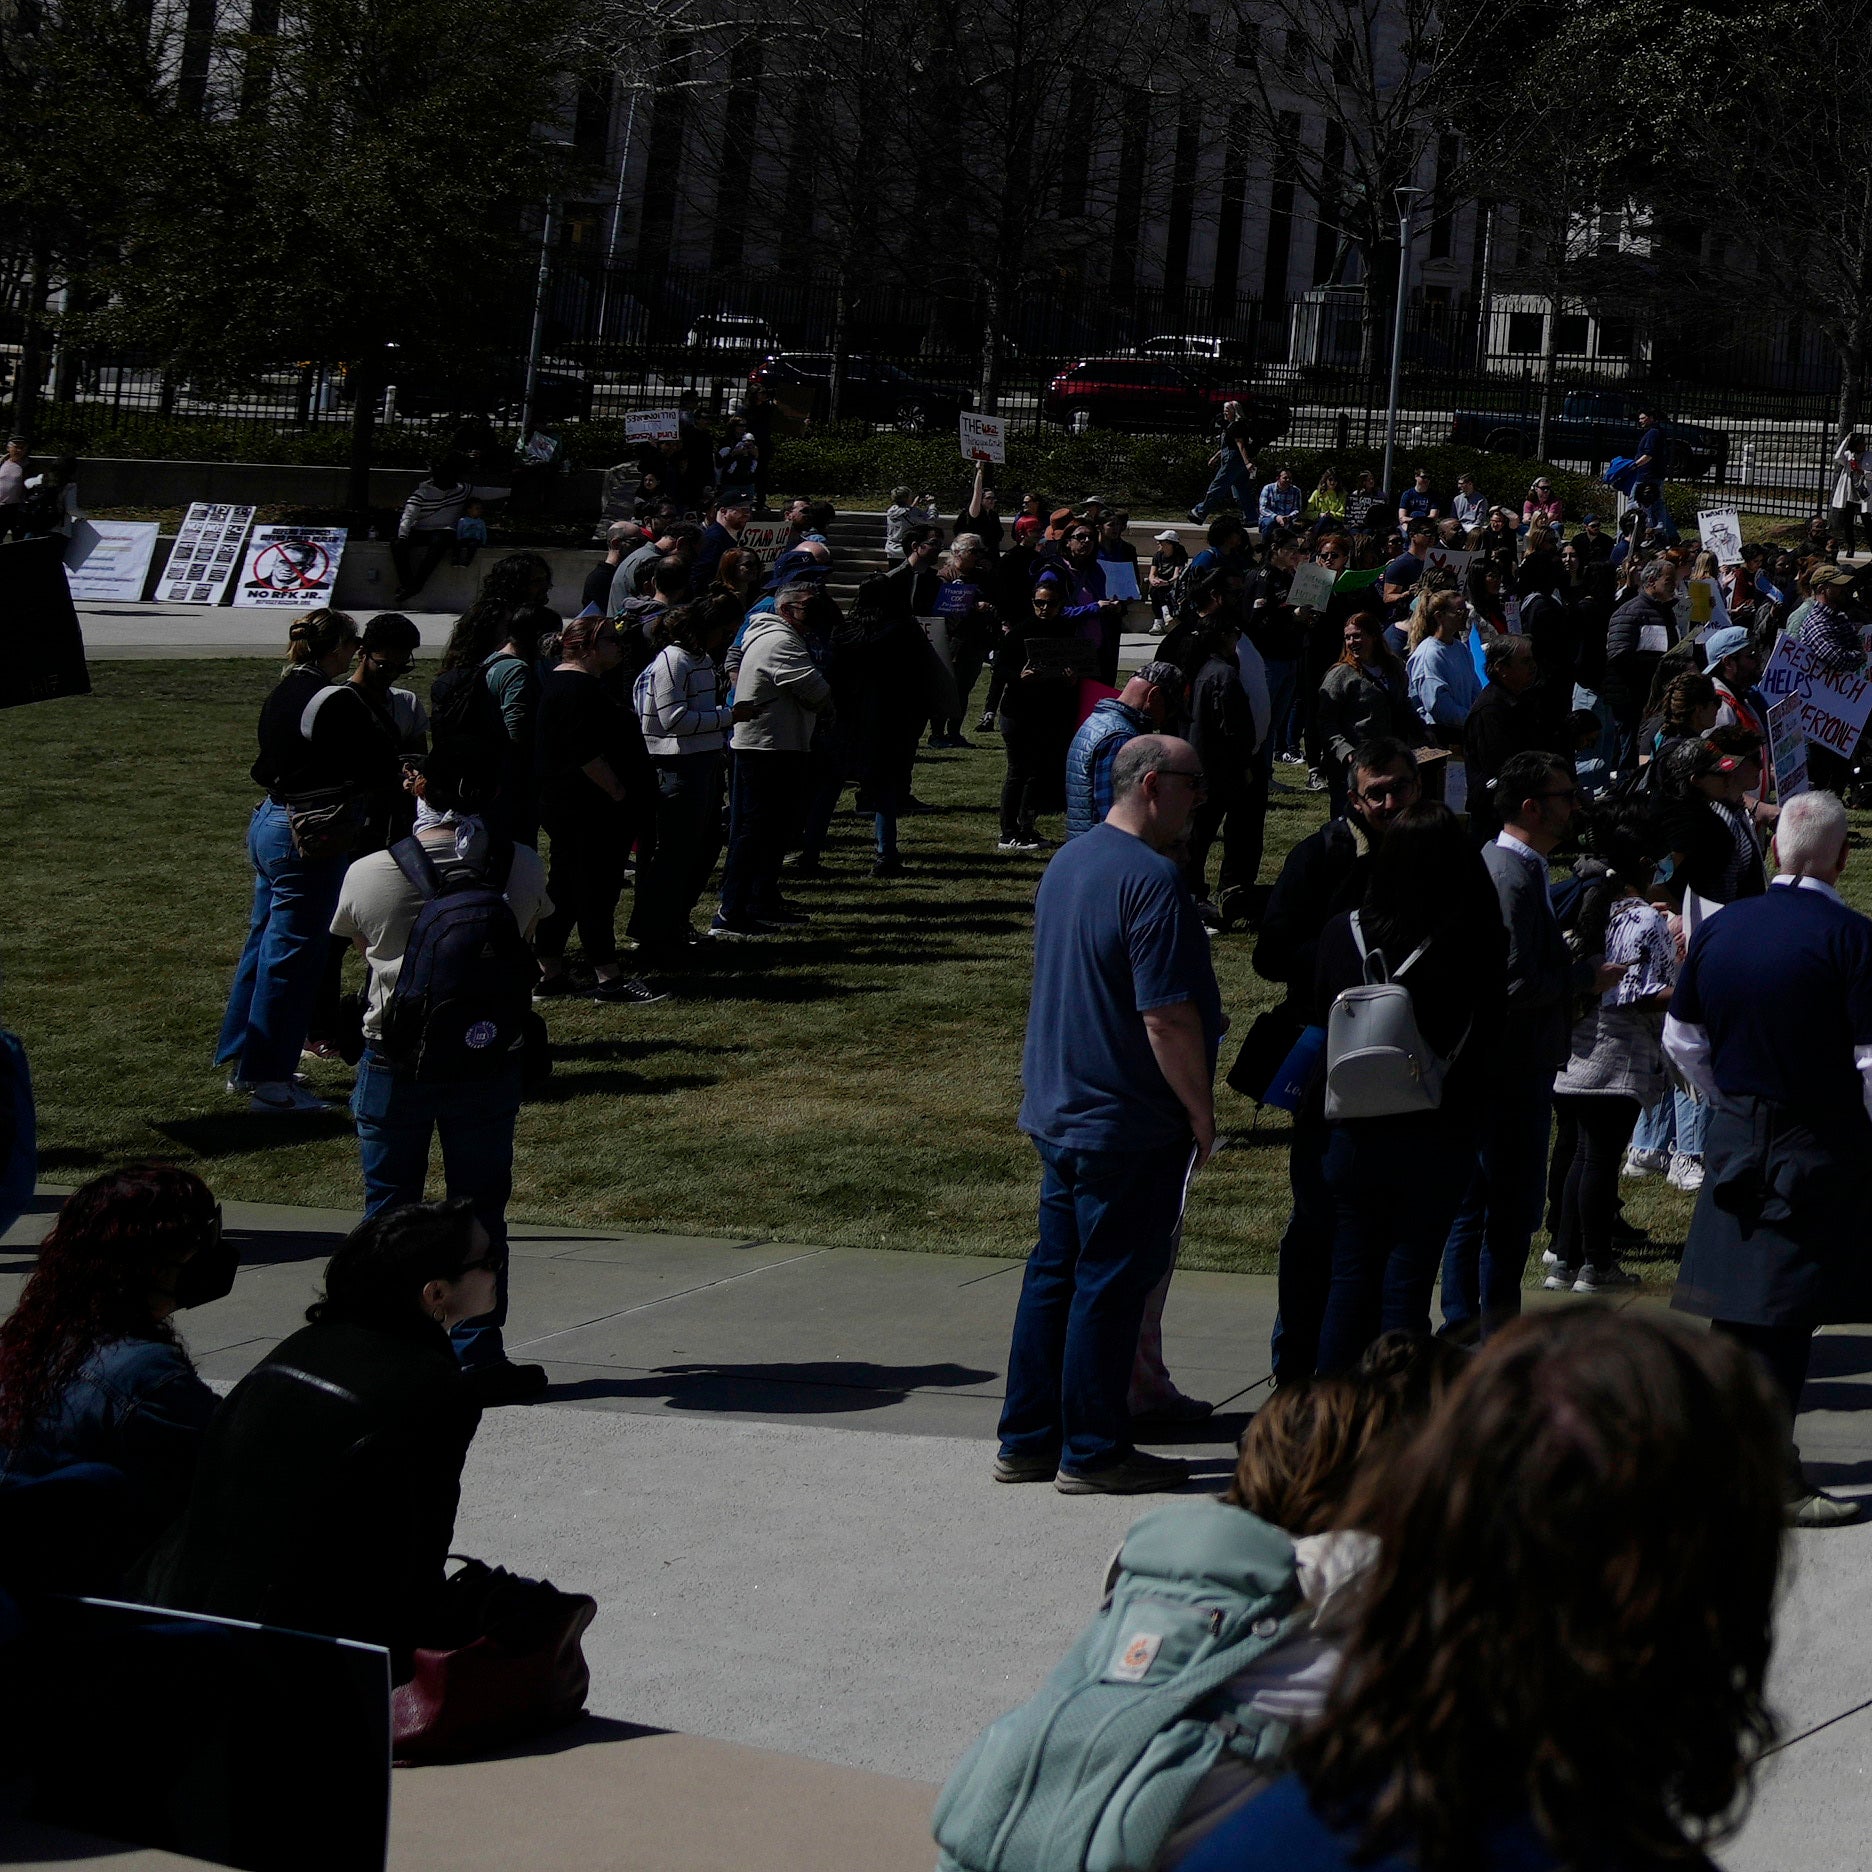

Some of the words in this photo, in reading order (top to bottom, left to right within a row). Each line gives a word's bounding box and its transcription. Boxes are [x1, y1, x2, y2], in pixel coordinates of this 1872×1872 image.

[739, 528, 774, 547] STAND
[776, 527, 792, 544] UP
[247, 590, 269, 598] NO
[271, 591, 299, 599] RFK
[1764, 668, 1813, 699] HELPS
[1779, 639, 1867, 704] RESEARCH
